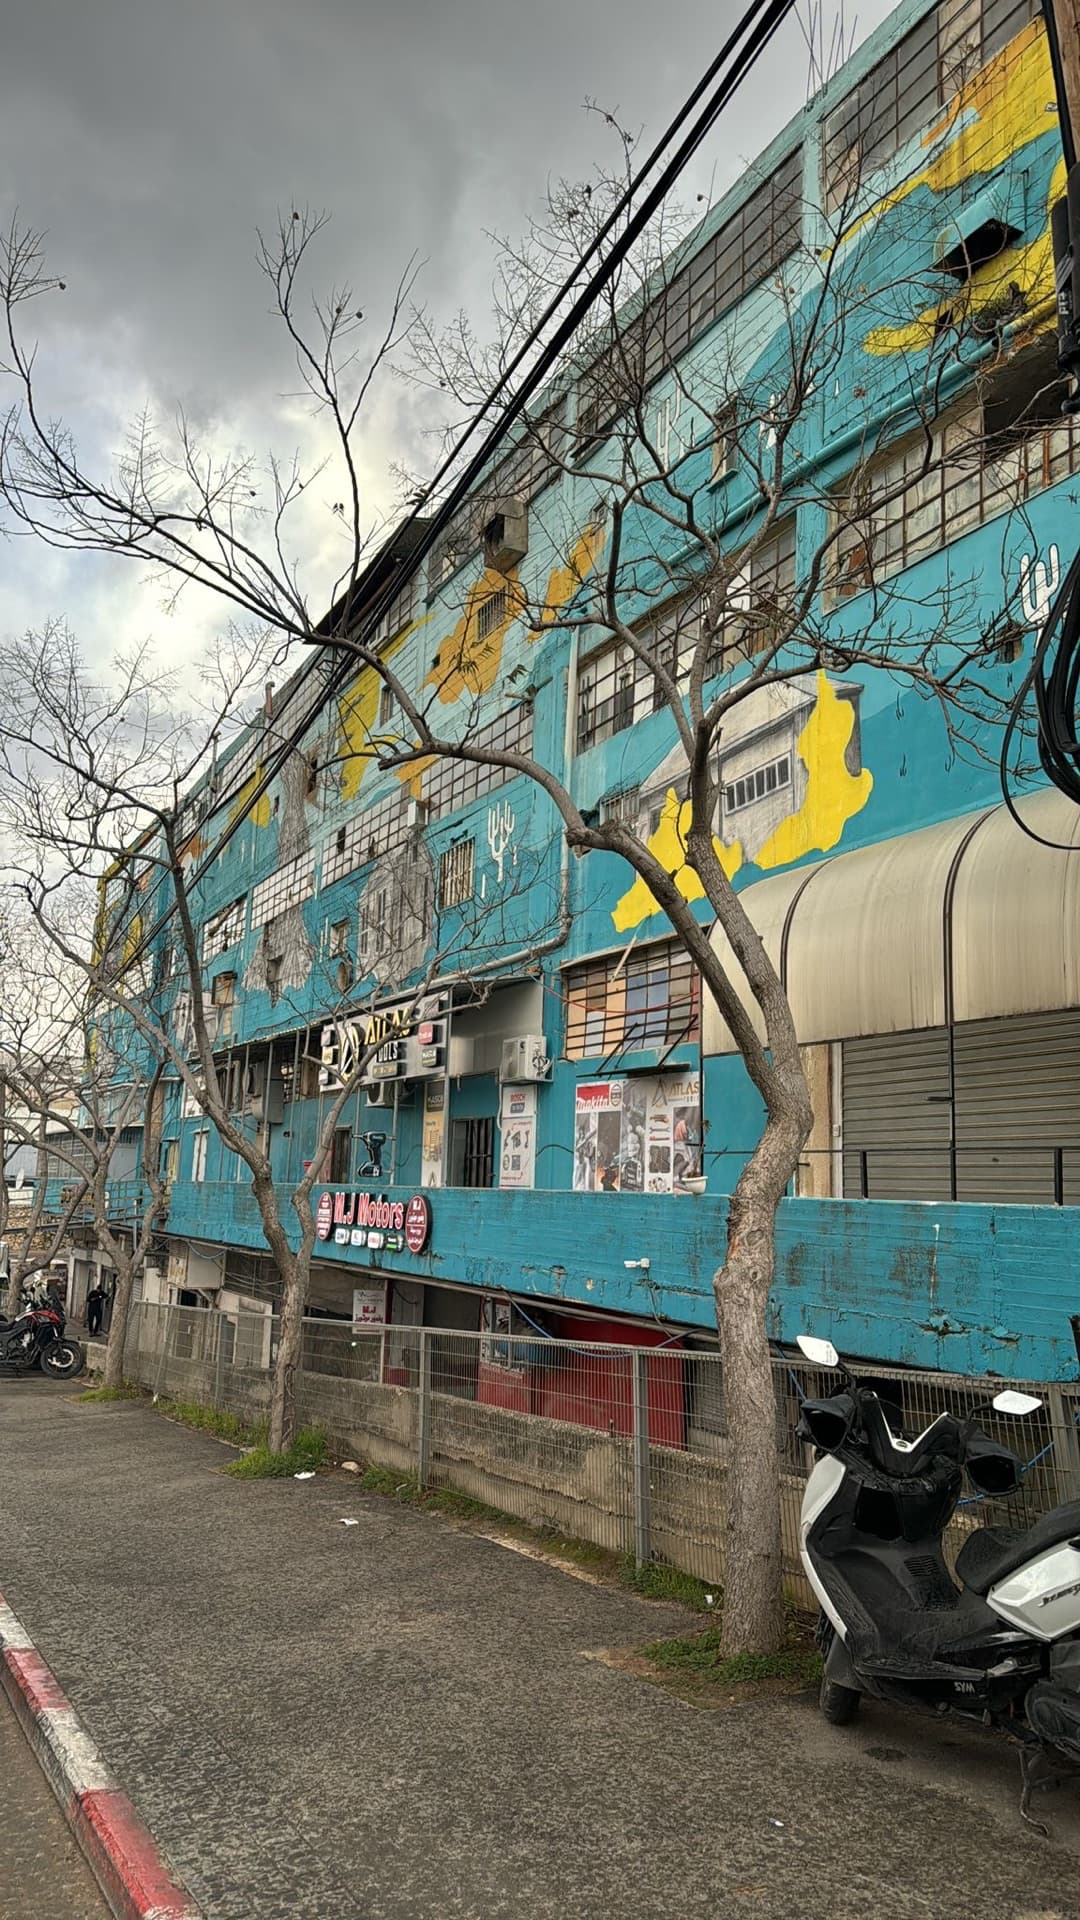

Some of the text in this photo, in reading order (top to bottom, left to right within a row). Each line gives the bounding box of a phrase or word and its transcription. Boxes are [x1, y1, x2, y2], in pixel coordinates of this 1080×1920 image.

[668, 1081, 699, 1096] ATLAS
[334, 1192, 355, 1225] M.J
[357, 1193, 404, 1230] Motors
[954, 1681, 975, 1693] SYM
